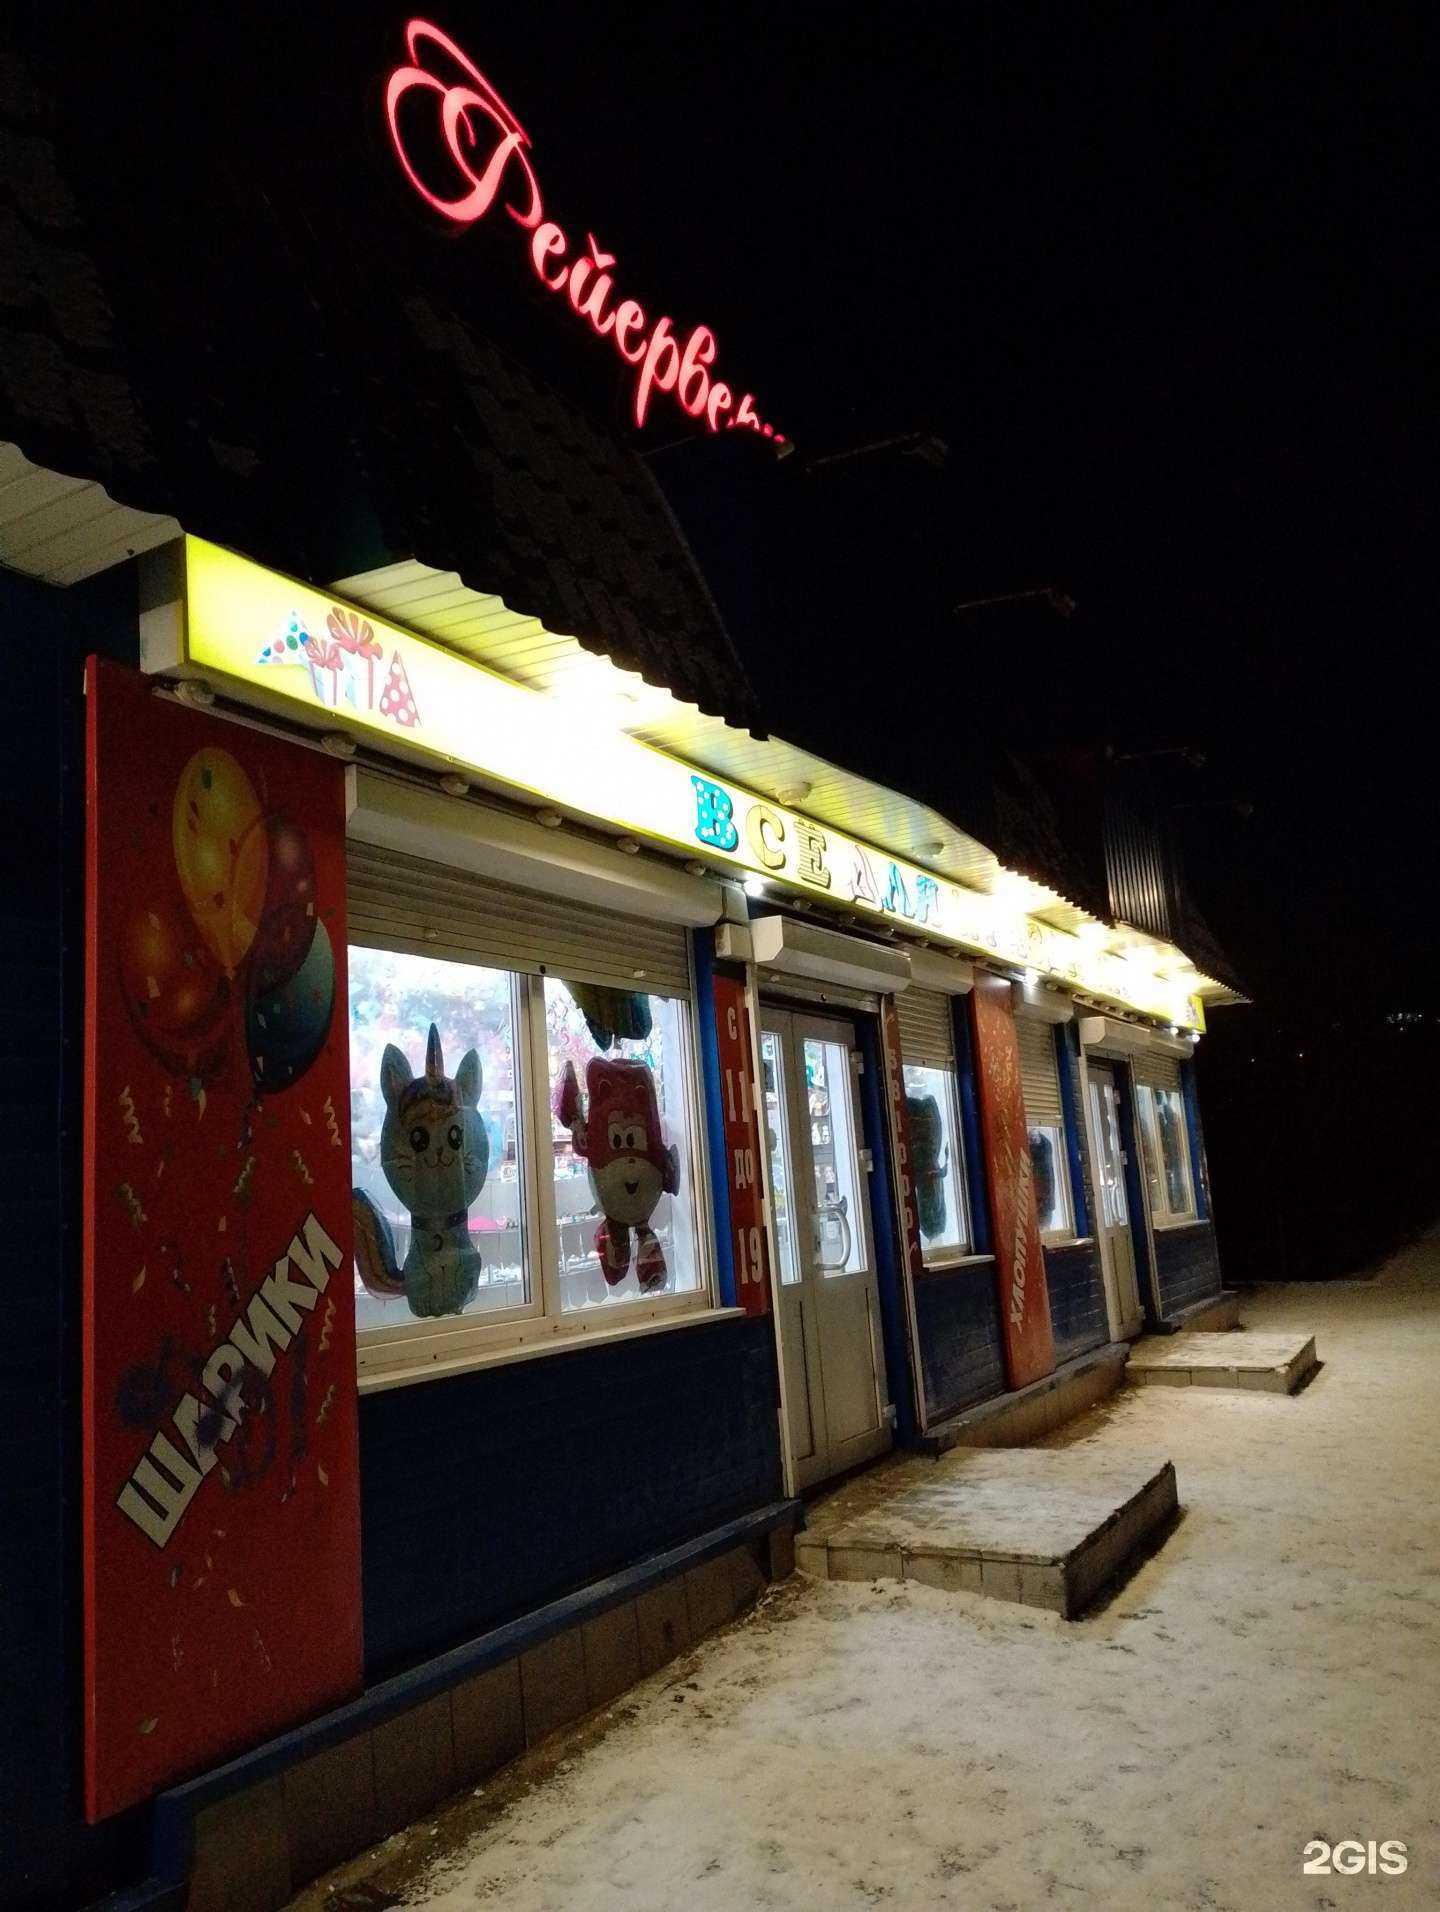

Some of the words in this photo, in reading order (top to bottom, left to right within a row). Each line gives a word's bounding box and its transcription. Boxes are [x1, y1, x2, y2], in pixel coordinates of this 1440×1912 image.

[386, 19, 786, 443] Фейерве
[690, 774, 832, 890] ВСЕ
[737, 1226, 764, 1284] 19
[1008, 1147, 1031, 1335] ХЛОПУШКИ
[116, 1211, 345, 1549] ШАРИКИ
